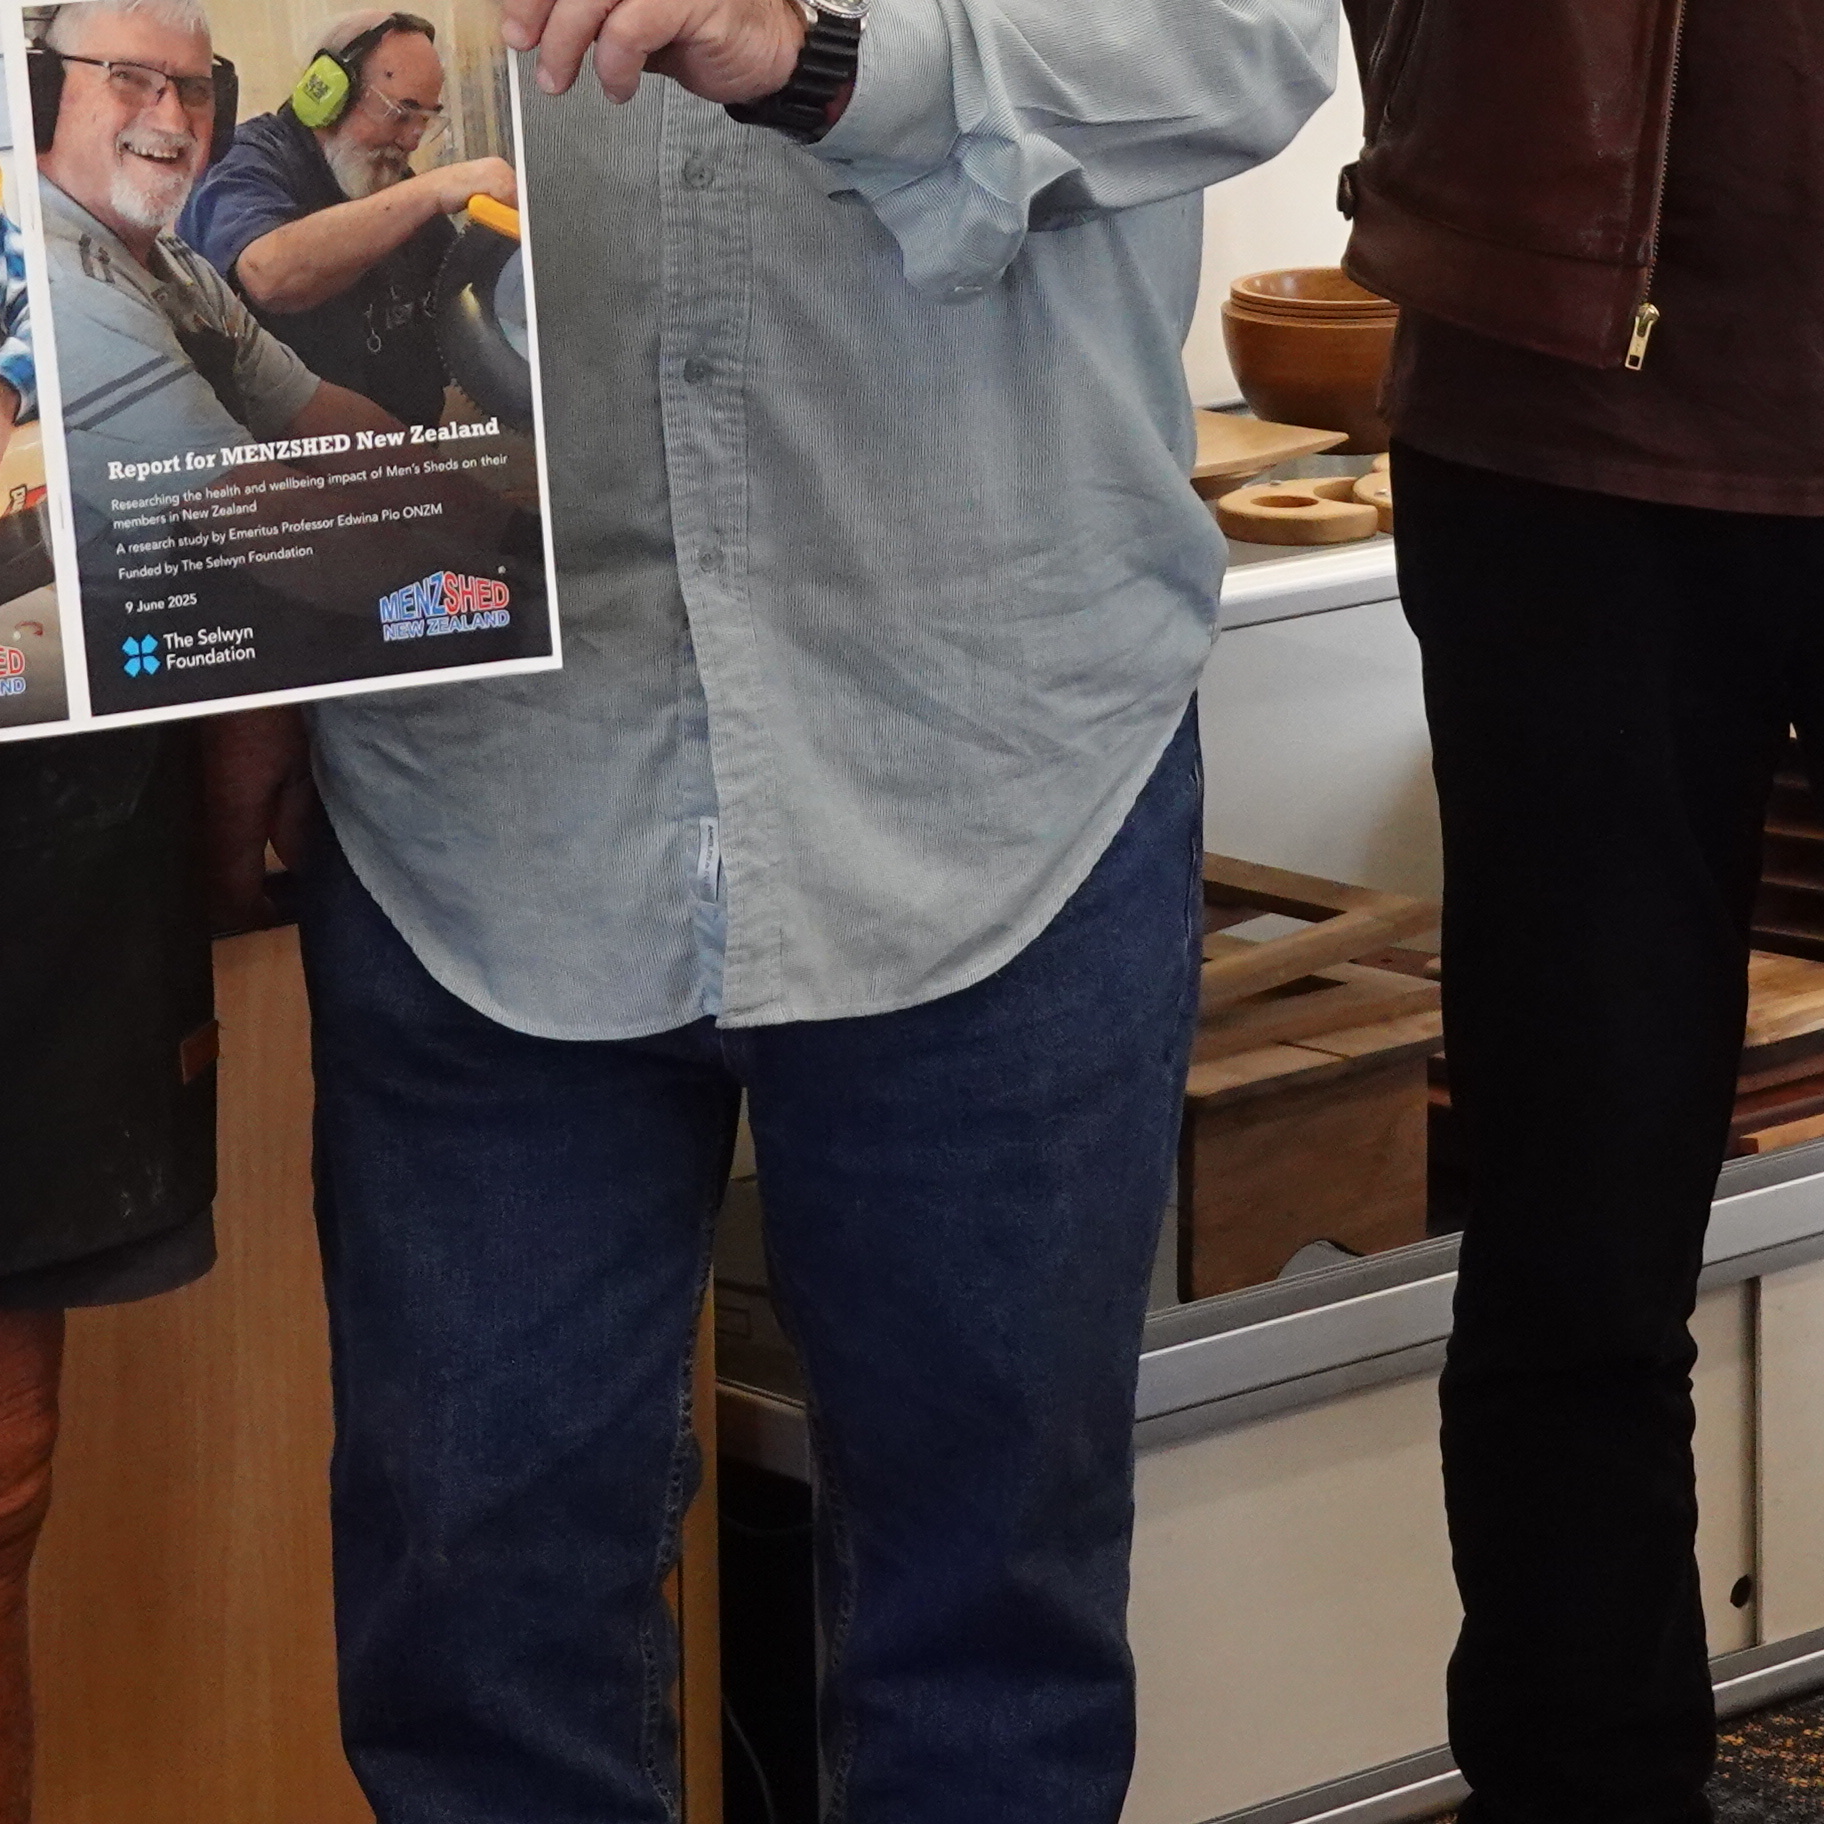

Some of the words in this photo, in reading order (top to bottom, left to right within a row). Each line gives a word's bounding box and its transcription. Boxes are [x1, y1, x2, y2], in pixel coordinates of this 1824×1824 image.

[107, 455, 181, 481] Report
[185, 452, 216, 470] for
[220, 434, 351, 466] MENZSHED
[356, 430, 406, 450] New
[410, 417, 500, 444] Zealand
[111, 493, 180, 511] Researching
[183, 488, 202, 502] the
[206, 484, 241, 499] health
[244, 480, 267, 495] and
[269, 475, 325, 491] wellbeing
[328, 470, 367, 486] impact
[371, 467, 383, 479] of
[386, 463, 420, 477] Men's
[424, 458, 459, 473] Sheds
[462, 459, 477, 469] on
[481, 454, 508, 467] their
[113, 514, 166, 529] members
[169, 512, 179, 523] in
[182, 509, 209, 521] New
[211, 500, 257, 518] Zealand
[116, 543, 126, 555] A
[128, 537, 175, 553] research
[178, 533, 209, 548] study
[212, 531, 226, 544] by
[229, 525, 279, 540] Emeritus
[282, 518, 334, 533] Professor
[337, 513, 378, 526] Edwina
[381, 509, 400, 521] Pio
[403, 503, 443, 519] ONZM
[119, 564, 162, 580] Funded
[165, 562, 179, 576] by
[181, 559, 203, 572] The
[206, 554, 246, 569] Selwyn
[248, 546, 313, 564] Foundation
[125, 602, 133, 614] 9
[137, 600, 165, 613] June
[168, 593, 197, 609] 2025
[379, 571, 509, 623] MENZSHED
[163, 631, 194, 650] The
[197, 626, 254, 645] Selwyn
[382, 619, 425, 642] NEW
[426, 610, 510, 636] ZEALAND
[166, 646, 256, 671] Foundation
